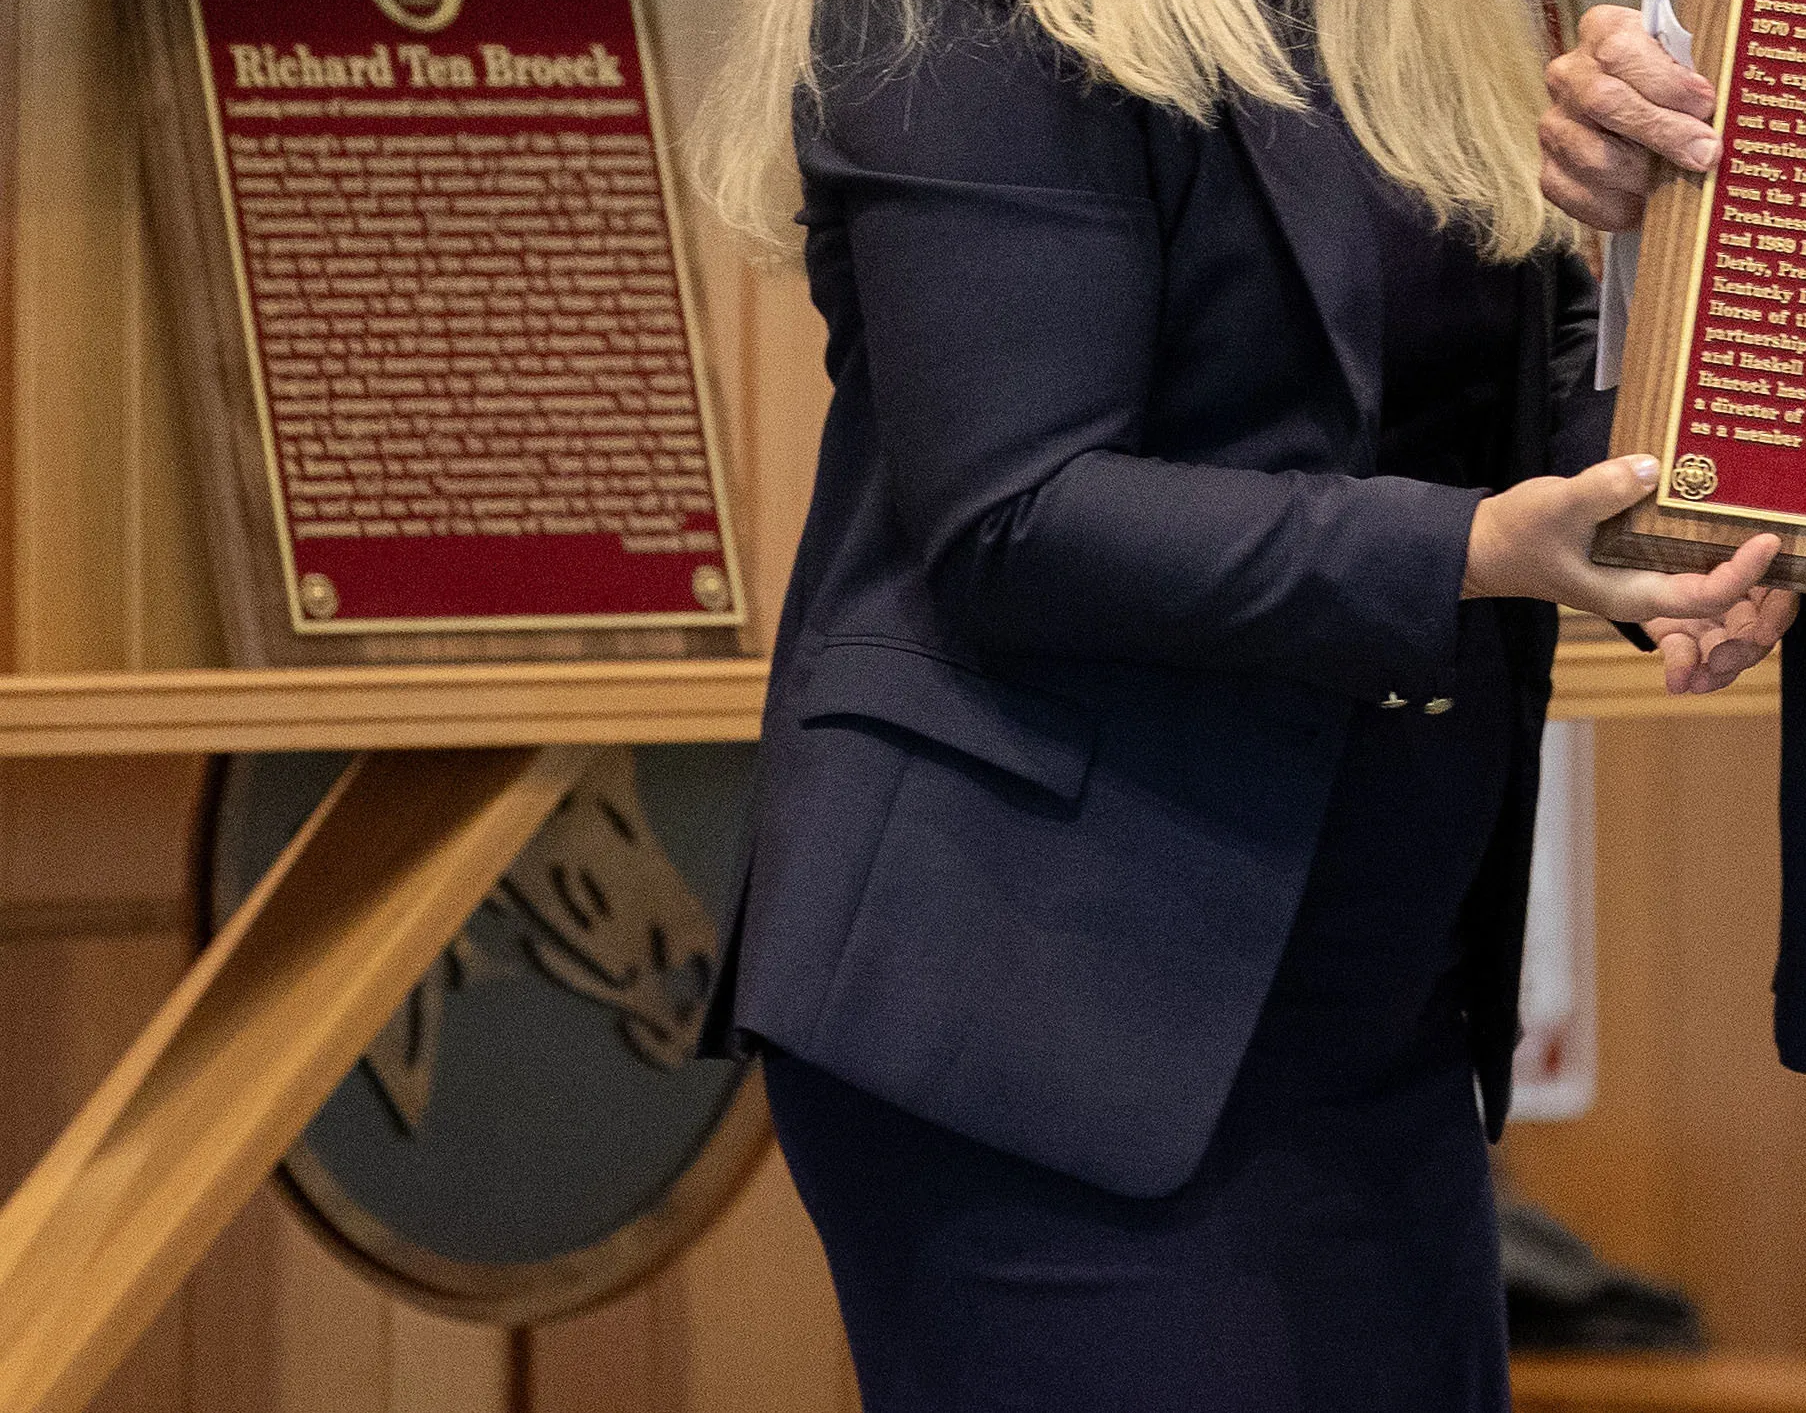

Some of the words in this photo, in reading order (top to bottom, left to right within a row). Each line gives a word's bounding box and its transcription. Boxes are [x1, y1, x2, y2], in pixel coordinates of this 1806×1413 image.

[229, 43, 396, 87] Richard
[398, 44, 475, 88] Ten
[481, 44, 624, 88] Broeck
[1766, 188, 1794, 204] the
[1719, 232, 1751, 247] and
[1713, 275, 1793, 303] Kentucky
[1709, 300, 1761, 321] Horse
[1767, 309, 1790, 324] of
[1701, 350, 1734, 365] and
[1698, 370, 1770, 394] Hancock
[1776, 381, 1806, 399] has
[1784, 407, 1804, 423] of
